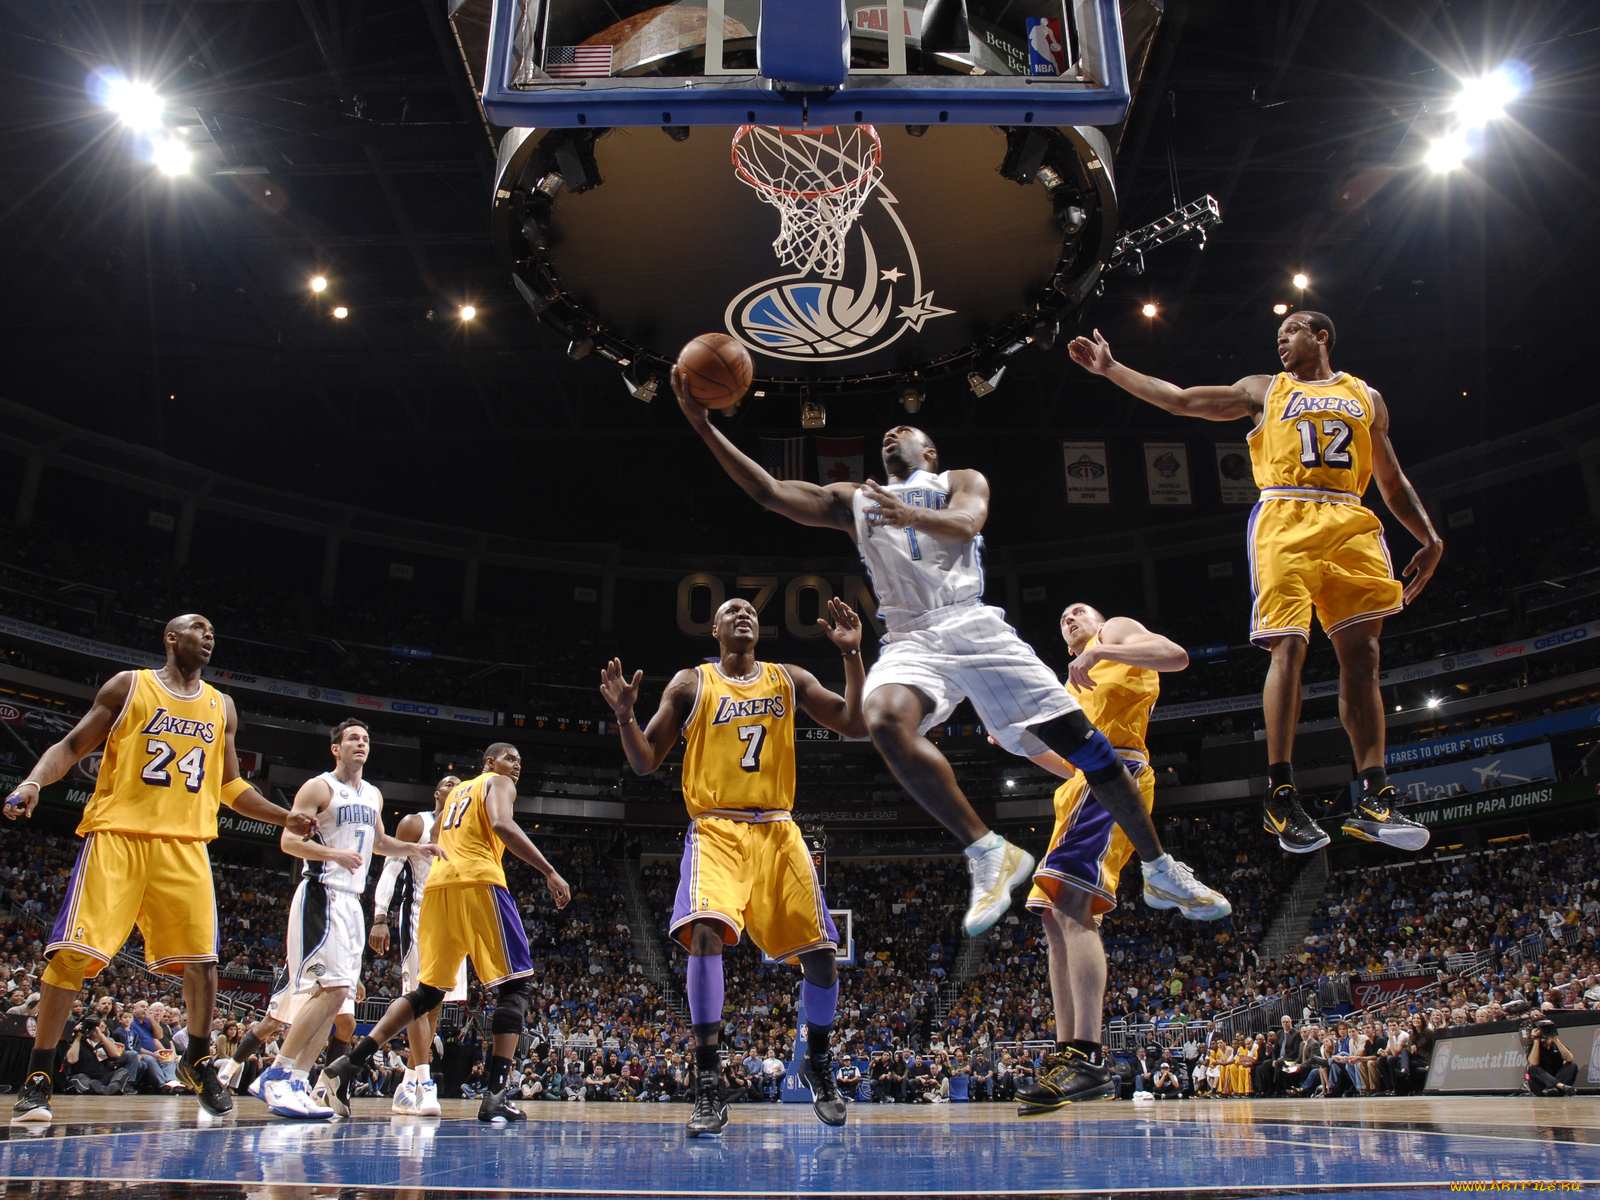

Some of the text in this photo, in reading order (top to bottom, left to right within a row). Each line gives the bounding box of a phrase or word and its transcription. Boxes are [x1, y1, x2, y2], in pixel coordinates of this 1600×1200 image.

[985, 30, 1024, 60] Better
[1034, 63, 1055, 73] NBA
[1280, 391, 1366, 421] LAKERS
[1296, 419, 1354, 470] 12
[904, 526, 922, 561] 1
[1534, 627, 1588, 651] GEICO
[213, 670, 257, 684] HARRIS
[1308, 684, 1338, 696] Amway
[391, 701, 439, 716] GEICO
[711, 695, 787, 726] LAKERS
[141, 708, 216, 744] LAKERS
[453, 713, 490, 724] PEPSICO
[514, 719, 525, 727] 18
[538, 720, 544, 729] 9
[559, 722, 566, 731] 4
[582, 724, 588, 733] 2
[805, 729, 830, 740] 4:52
[946, 726, 952, 737] 1
[975, 724, 982, 735] 4
[737, 724, 767, 772] 7
[1390, 750, 1418, 764] FARES
[1420, 746, 1432, 758] TO
[1433, 741, 1458, 757] OVER
[1473, 733, 1505, 749] CITIES
[141, 739, 206, 794] 24
[442, 796, 473, 831] 17
[1414, 788, 1553, 824] WIN WITH PAPA JOHNS!
[873, 810, 898, 820] BAR
[235, 822, 277, 837] JOHNS!
[354, 829, 366, 854] 7
[1450, 1052, 1489, 1071] Connect
[1489, 1051, 1501, 1068] at
